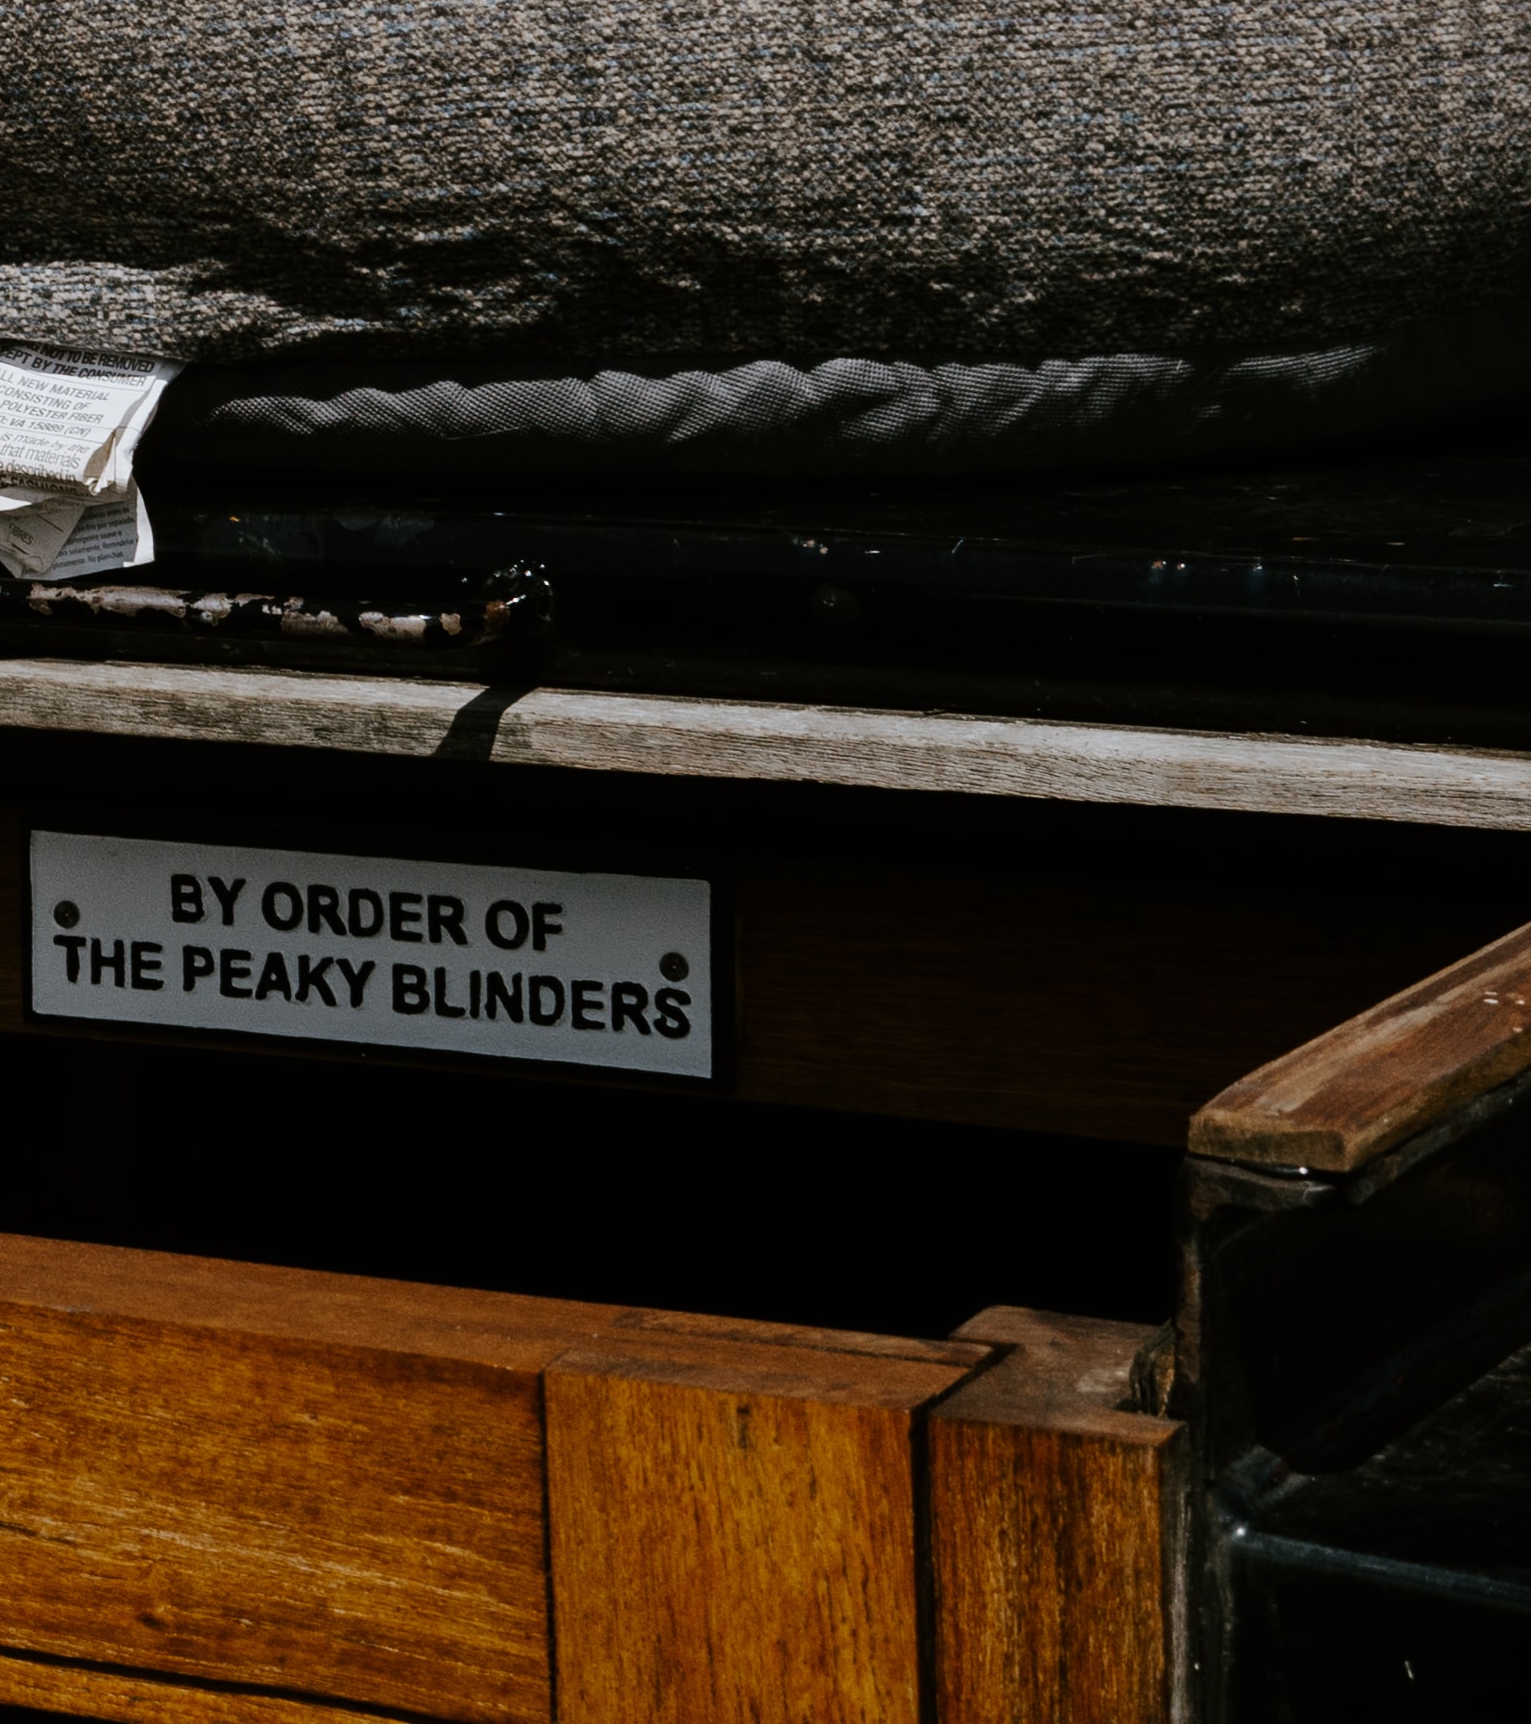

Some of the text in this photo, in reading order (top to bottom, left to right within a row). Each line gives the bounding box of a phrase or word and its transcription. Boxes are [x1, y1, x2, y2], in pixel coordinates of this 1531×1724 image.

[31, 357, 52, 373] BY
[53, 362, 78, 377] THE
[77, 367, 147, 388] CONSUMER
[66, 349, 81, 364] TO
[81, 351, 98, 366] BE
[98, 354, 156, 373] REMOVED
[18, 376, 49, 392] NEW
[49, 383, 110, 402] MATERIAL
[0, 399, 68, 420] POLYESTER
[67, 411, 105, 425] FIBER
[72, 400, 92, 411] OF
[8, 417, 27, 428] VA
[64, 425, 92, 438] (CN)
[0, 431, 13, 442] is
[12, 434, 51, 446] made
[66, 441, 92, 454] the
[0, 441, 24, 458] that
[24, 448, 83, 470] materials
[4, 460, 65, 480] described
[65, 472, 77, 484] in
[169, 873, 565, 953] BY ORDER OF
[52, 933, 693, 1040] THE PEAKY BLINDERS
